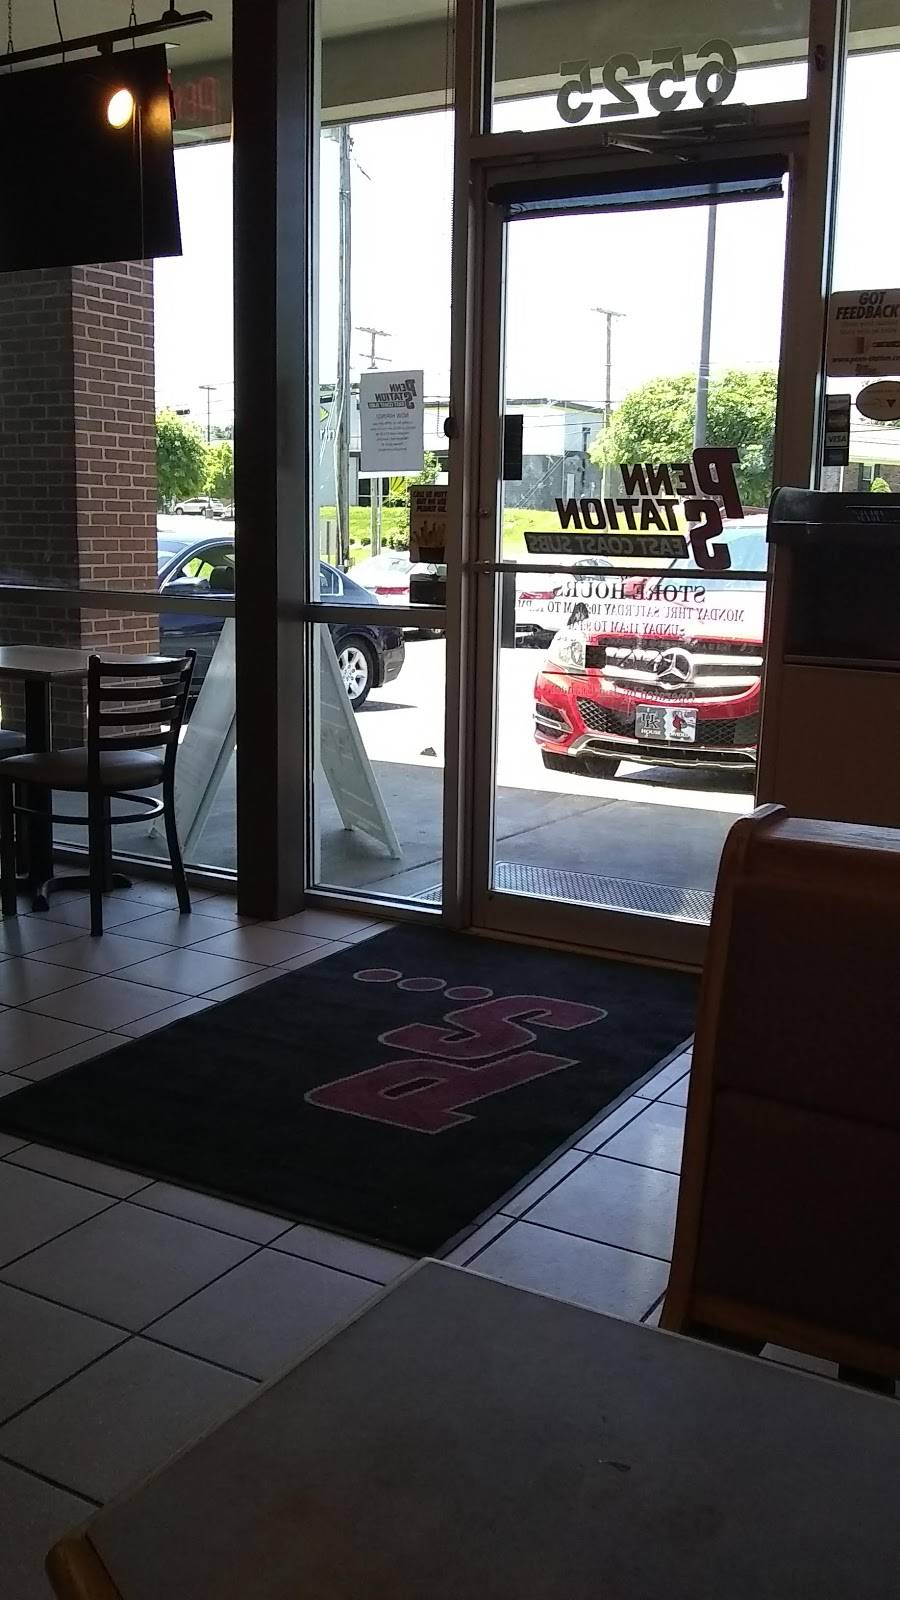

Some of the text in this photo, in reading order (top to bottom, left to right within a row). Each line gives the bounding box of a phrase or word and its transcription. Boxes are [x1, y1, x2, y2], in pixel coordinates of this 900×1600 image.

[858, 291, 888, 306] GOT
[828, 434, 847, 443] VISA
[640, 712, 661, 730] UK
